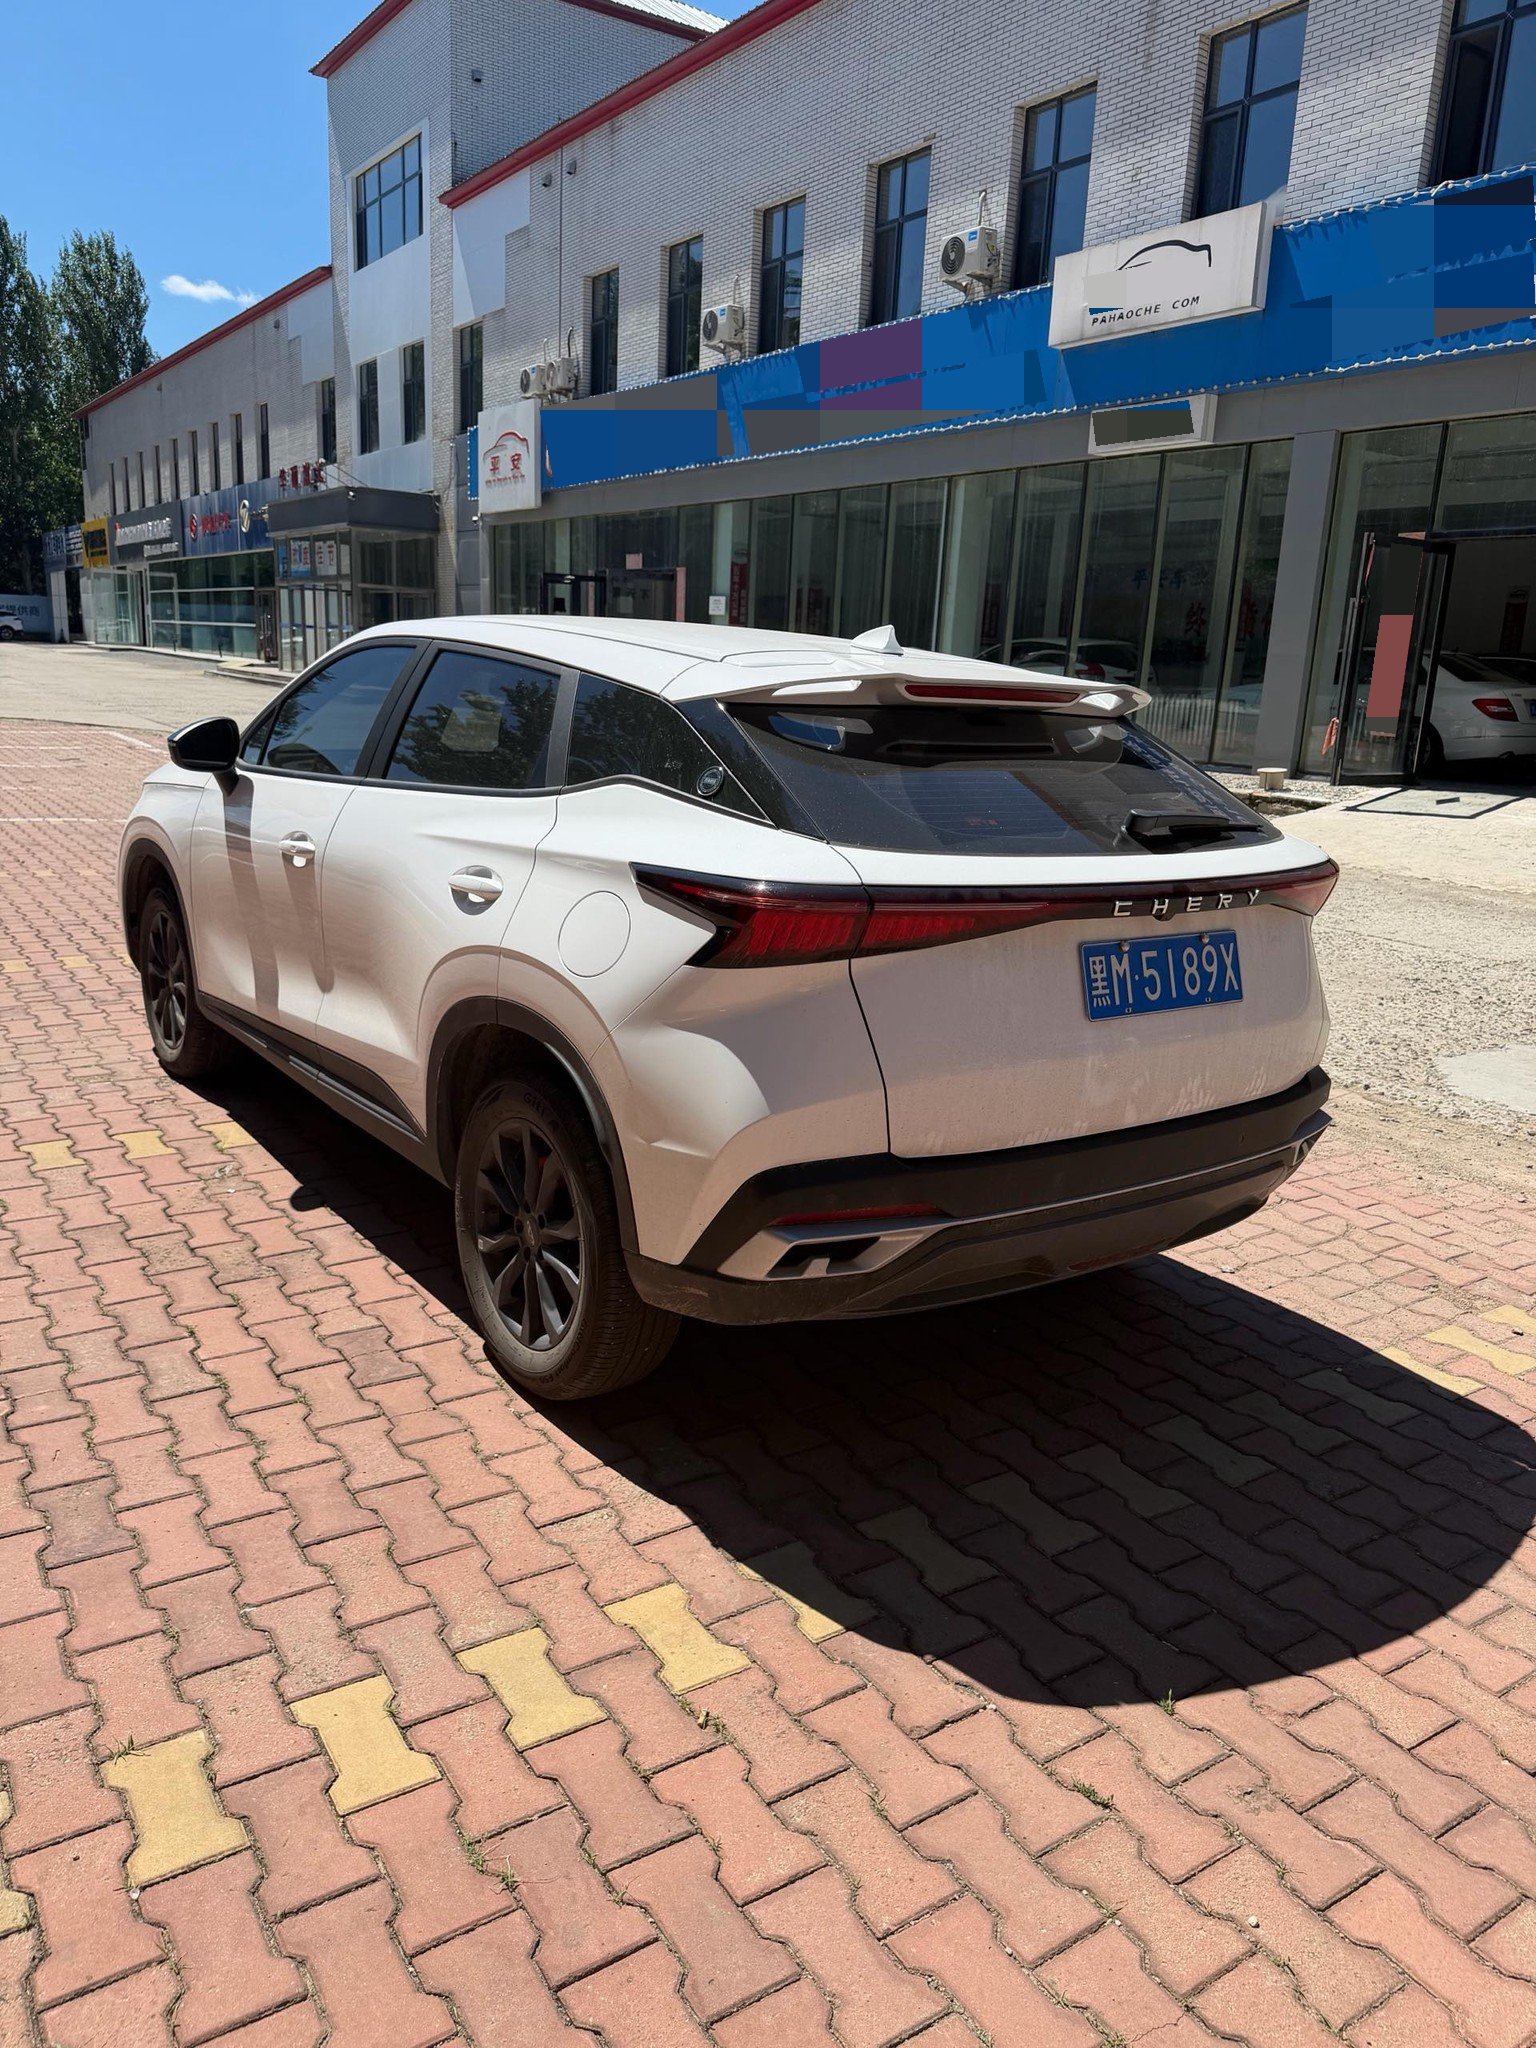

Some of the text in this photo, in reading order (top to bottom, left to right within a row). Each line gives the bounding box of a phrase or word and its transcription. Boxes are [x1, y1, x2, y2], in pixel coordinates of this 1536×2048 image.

[1091, 296, 1200, 326] PAHAOCHE COM
[490, 453, 521, 474] 平安
[1114, 889, 1260, 917] CHERY
